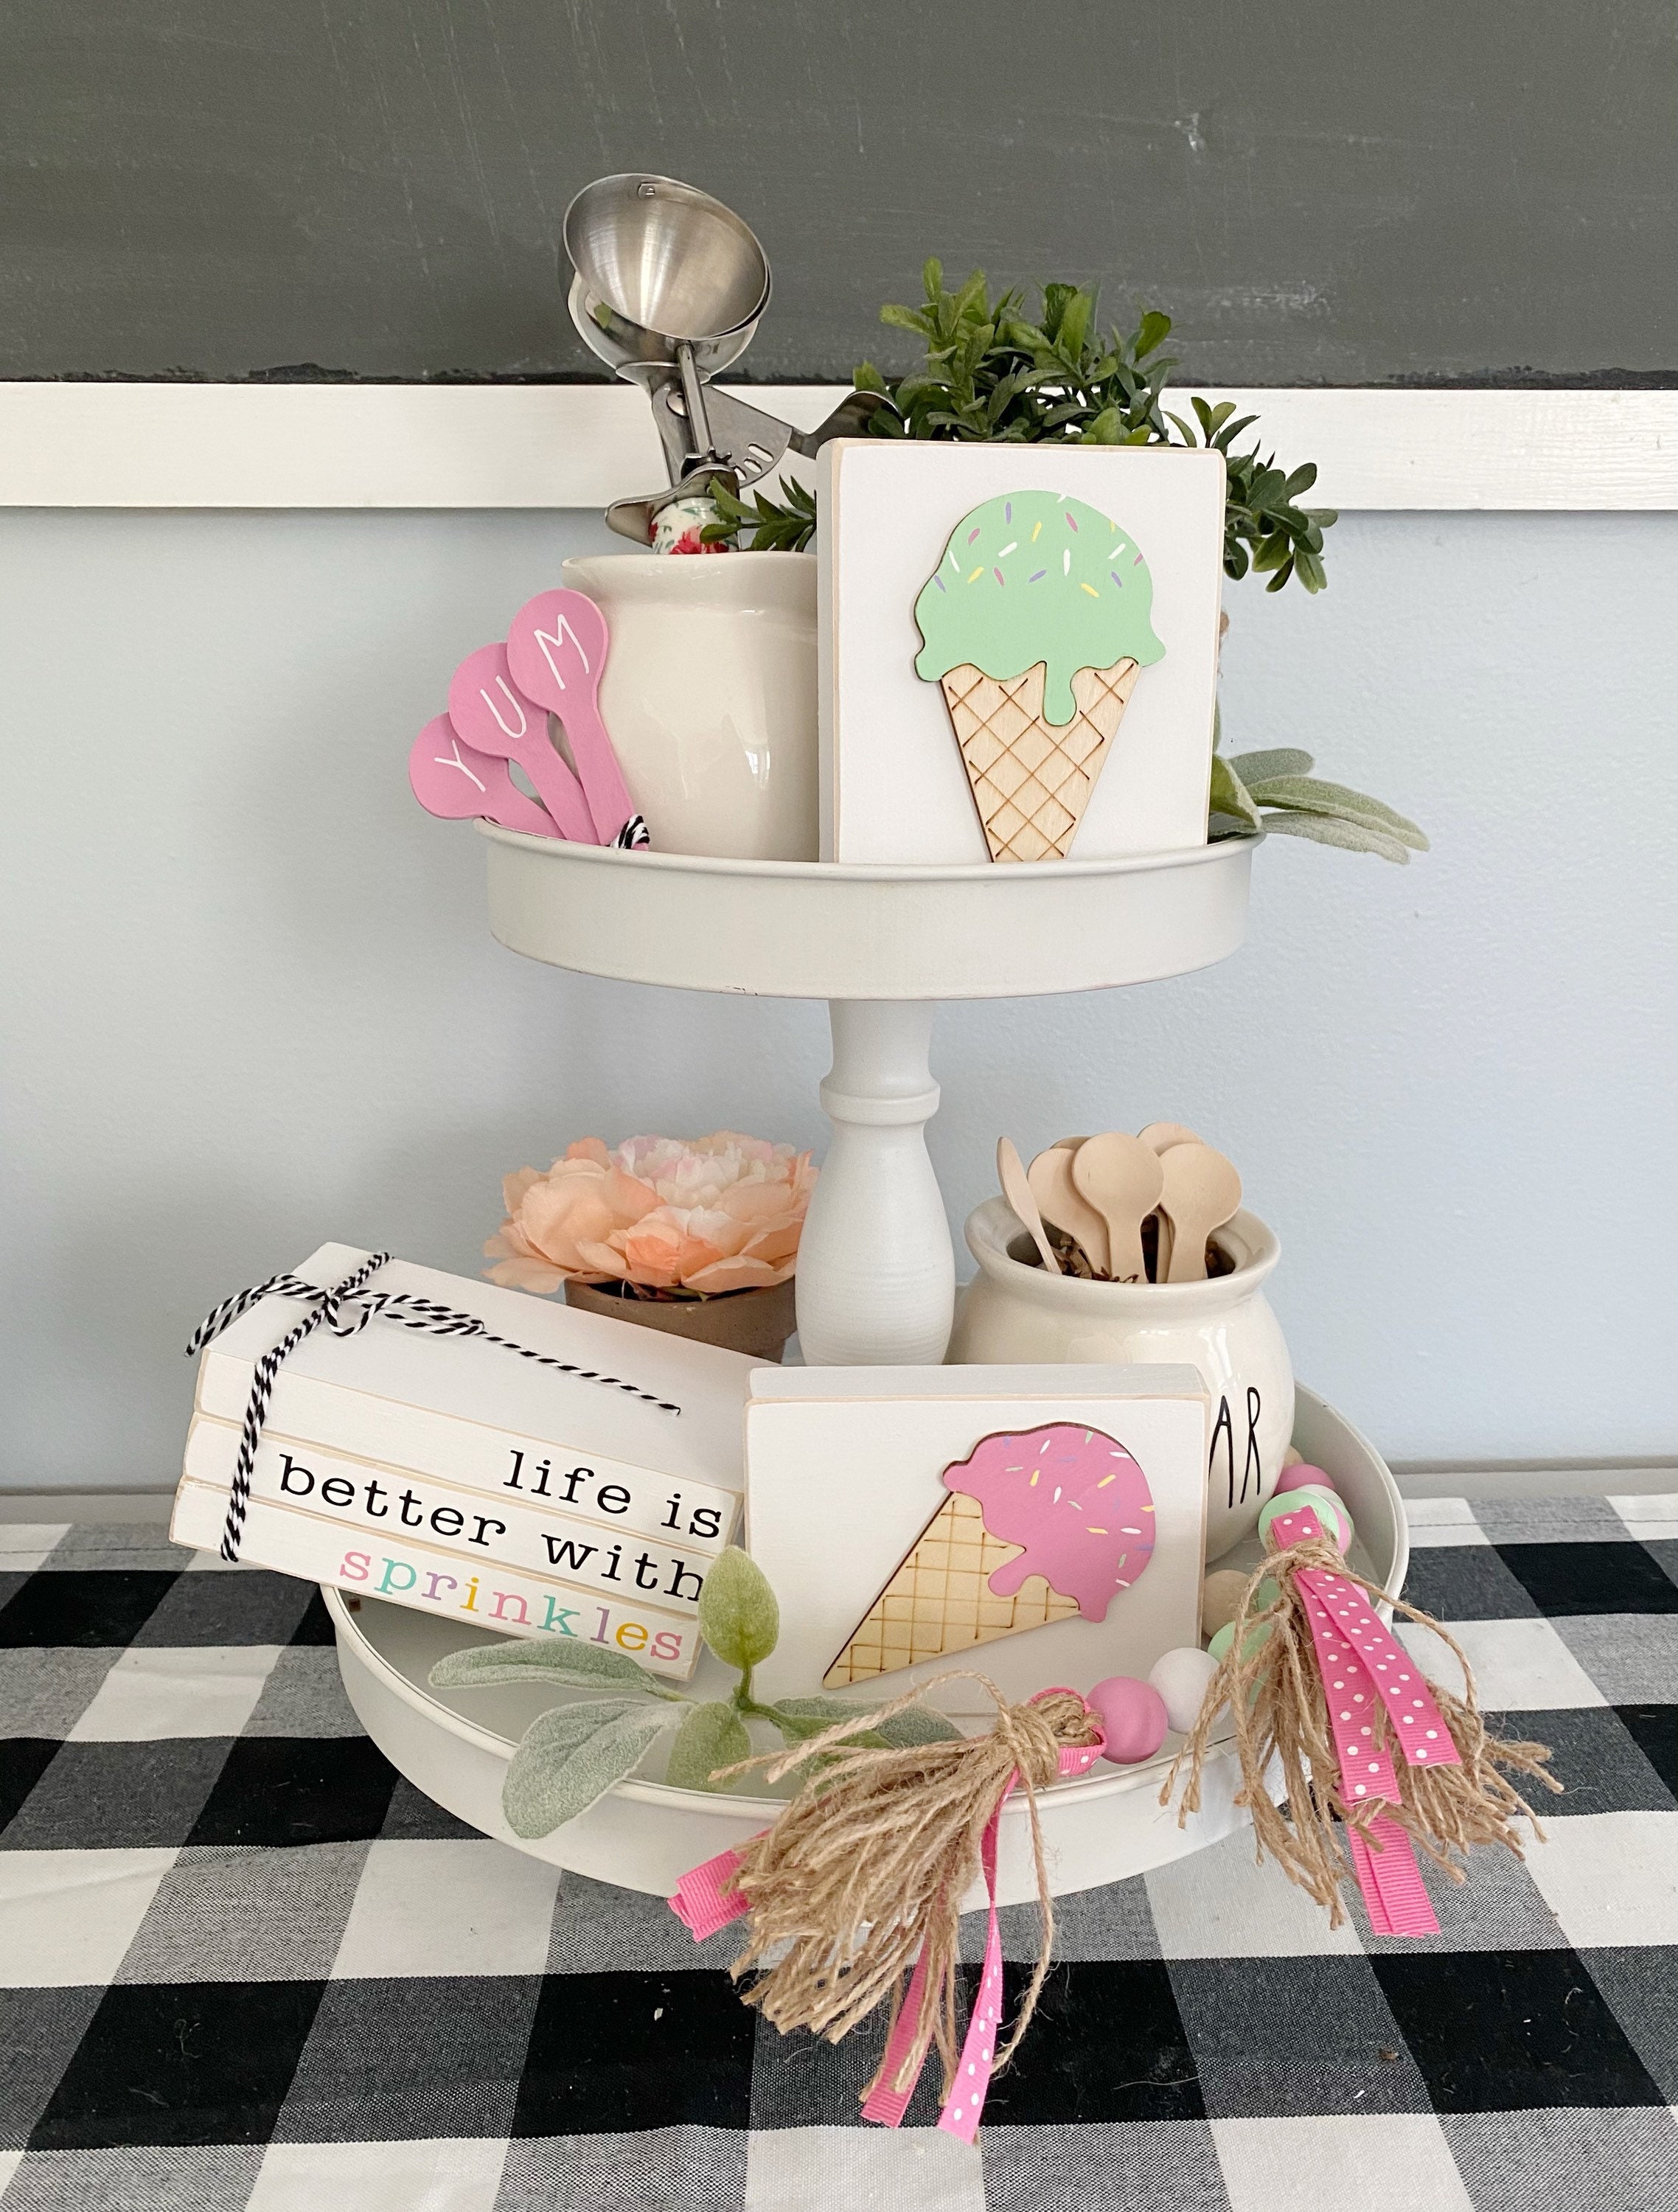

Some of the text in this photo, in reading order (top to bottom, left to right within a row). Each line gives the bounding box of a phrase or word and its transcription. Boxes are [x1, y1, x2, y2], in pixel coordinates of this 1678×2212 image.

[279, 1454, 705, 1603] better with
[503, 1450, 722, 1539] life is
[339, 1551, 682, 1661] sprinkles
